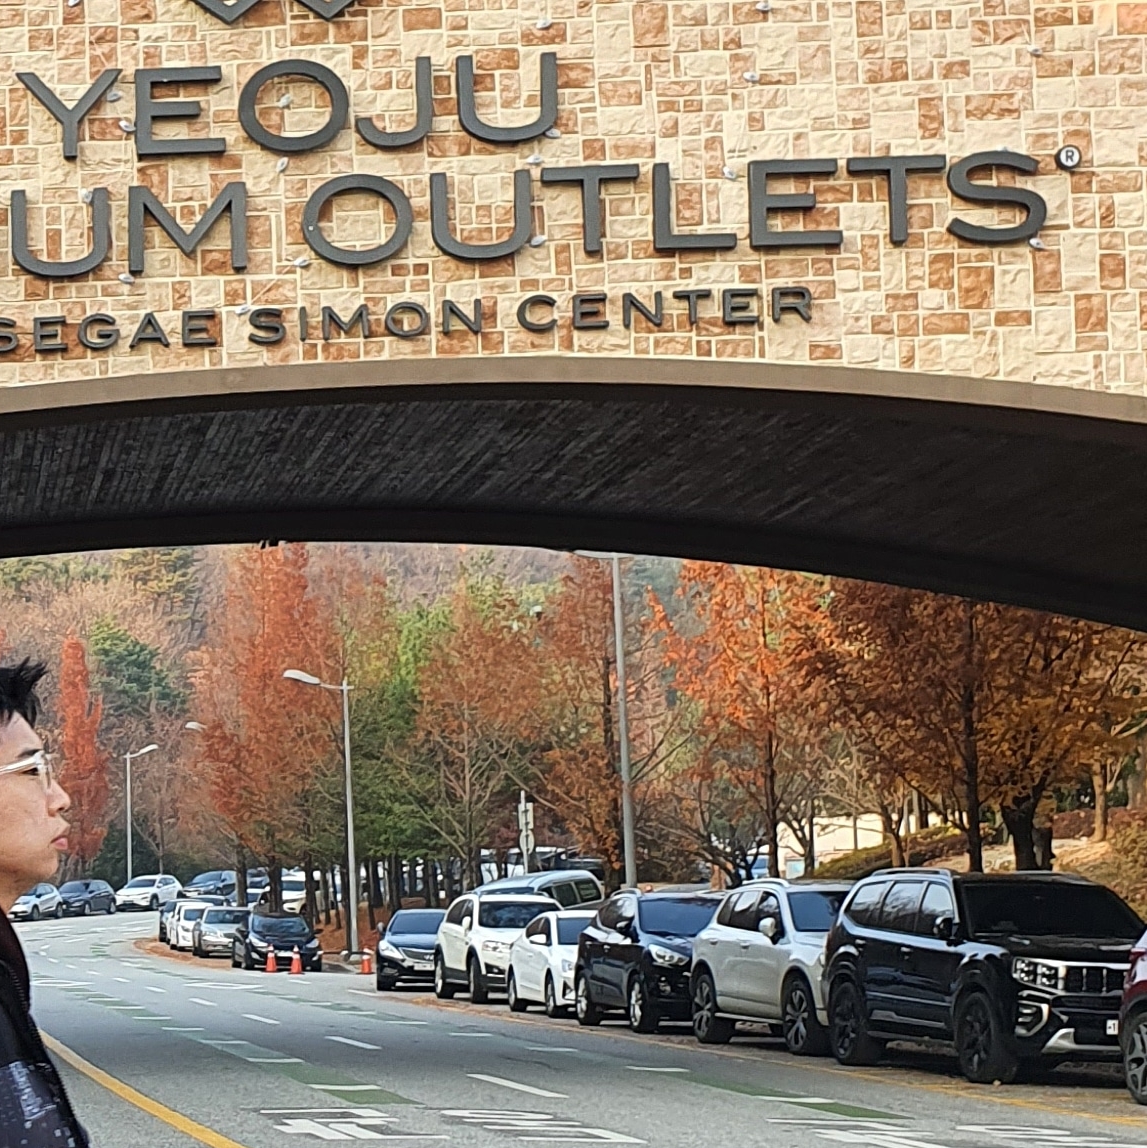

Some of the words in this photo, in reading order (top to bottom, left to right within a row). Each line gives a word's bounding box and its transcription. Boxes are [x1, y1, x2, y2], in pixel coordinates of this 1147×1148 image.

[16, 52, 558, 160] YEOJU
[247, 299, 483, 346] SIMON
[517, 286, 814, 334] CENTER
